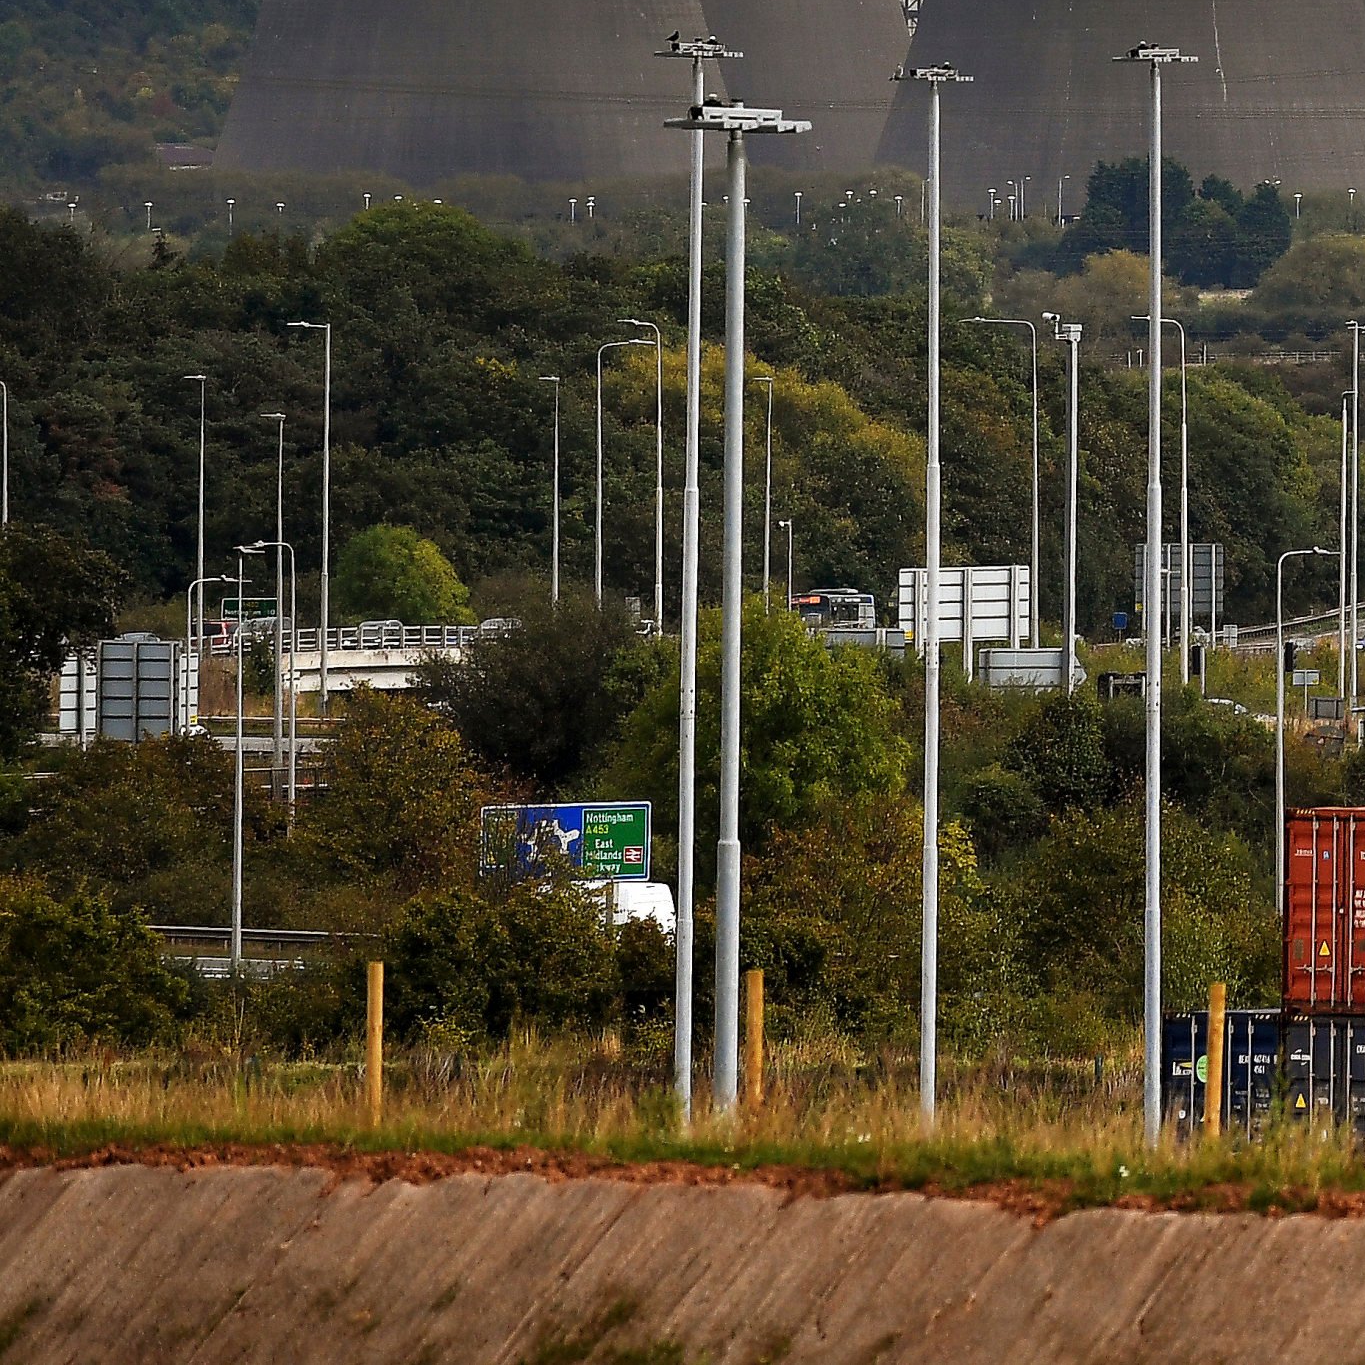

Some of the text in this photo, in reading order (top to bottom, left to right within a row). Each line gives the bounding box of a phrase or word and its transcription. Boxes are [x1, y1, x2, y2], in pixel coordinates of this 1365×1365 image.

[586, 813, 634, 824] Nottingham
[586, 825, 609, 834] A453
[595, 839, 613, 849] East
[586, 863, 621, 873] Pkway
